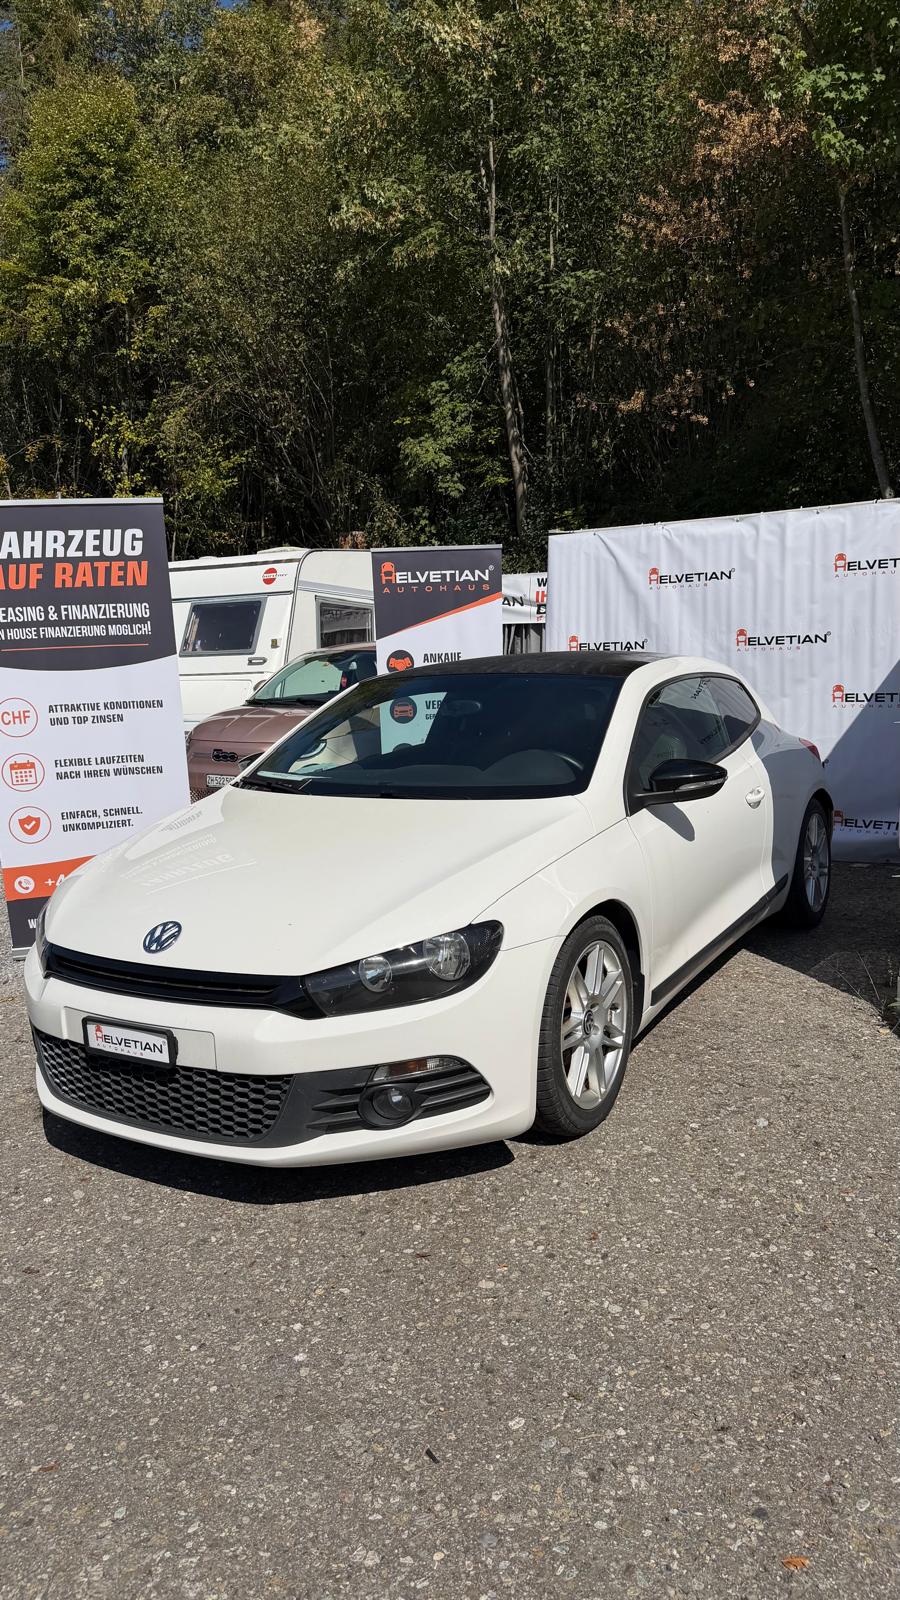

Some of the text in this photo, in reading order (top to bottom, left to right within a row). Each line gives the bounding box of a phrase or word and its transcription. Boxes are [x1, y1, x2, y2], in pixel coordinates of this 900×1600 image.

[0, 560, 148, 590] UF RATEN
[383, 583, 490, 594] AUTOHAUS
[48, 605, 58, 621] &
[61, 602, 150, 620] FINANZIERUNG
[7, 627, 38, 640] HOUSE
[40, 625, 106, 638] FINANZIERUNG
[48, 699, 164, 714] ATTRAKTIVE KONDITIONEN
[1, 710, 31, 726] CHF
[49, 713, 124, 727] UND TOP ZINSEN
[54, 754, 145, 768] FLEXIBLE LAUFZEITEN
[56, 765, 163, 781] NACH IHREN WÜNSCHEN
[61, 806, 143, 821] EINFACH, SCHNELL.
[62, 818, 134, 833] UNKOMPLIZIERT.
